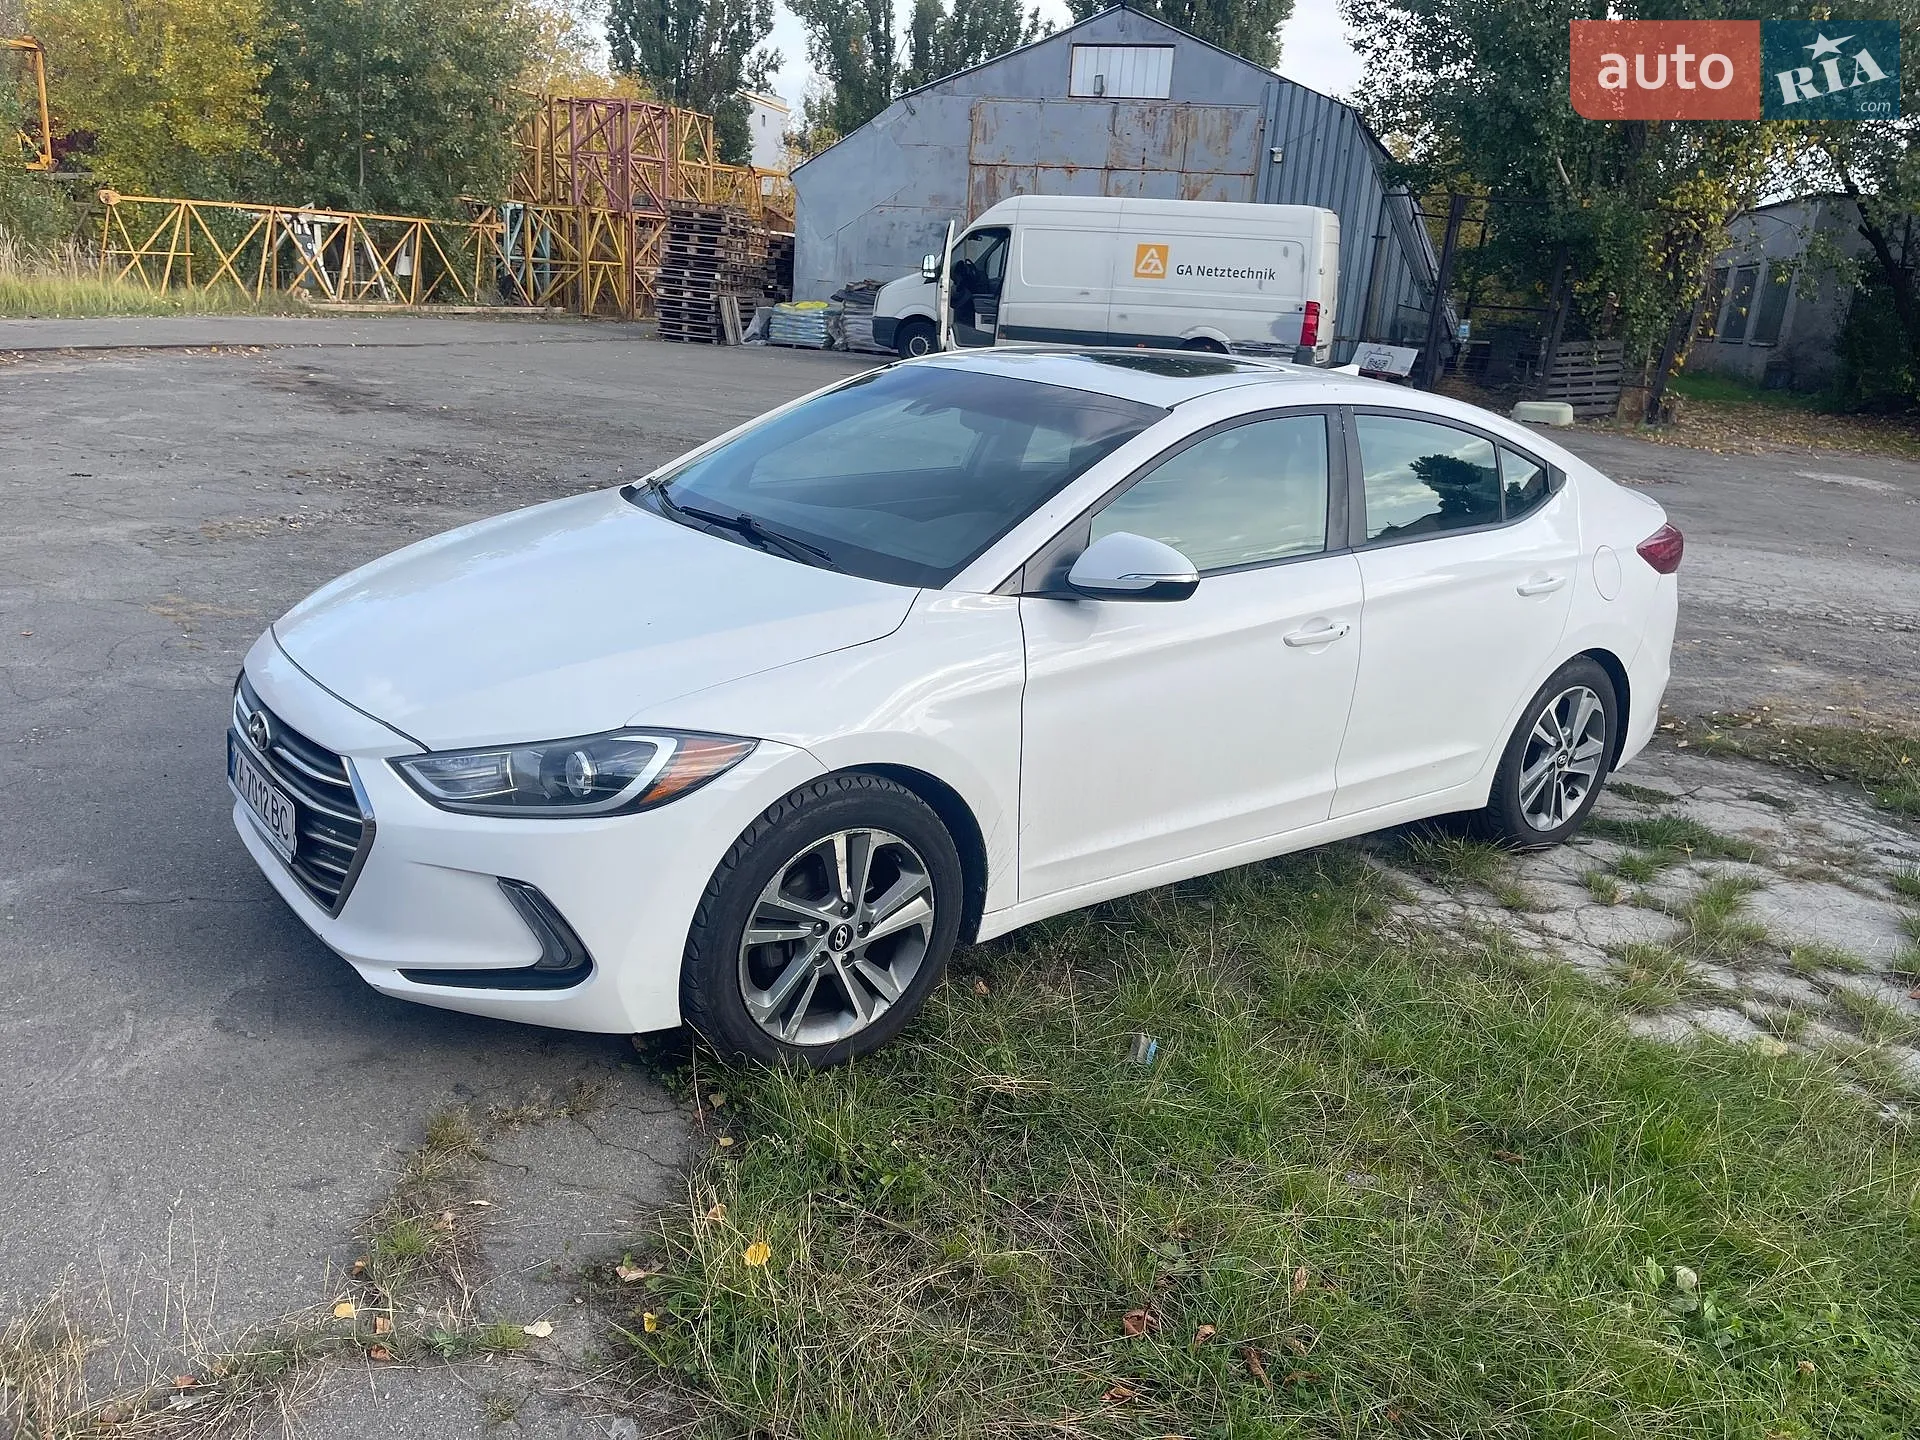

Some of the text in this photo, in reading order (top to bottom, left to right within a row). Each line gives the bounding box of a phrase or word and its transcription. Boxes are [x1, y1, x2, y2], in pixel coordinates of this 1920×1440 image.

[1176, 264, 1276, 280] GA Netztechnik
[246, 766, 269, 821] 7012
[271, 794, 289, 840] BC
